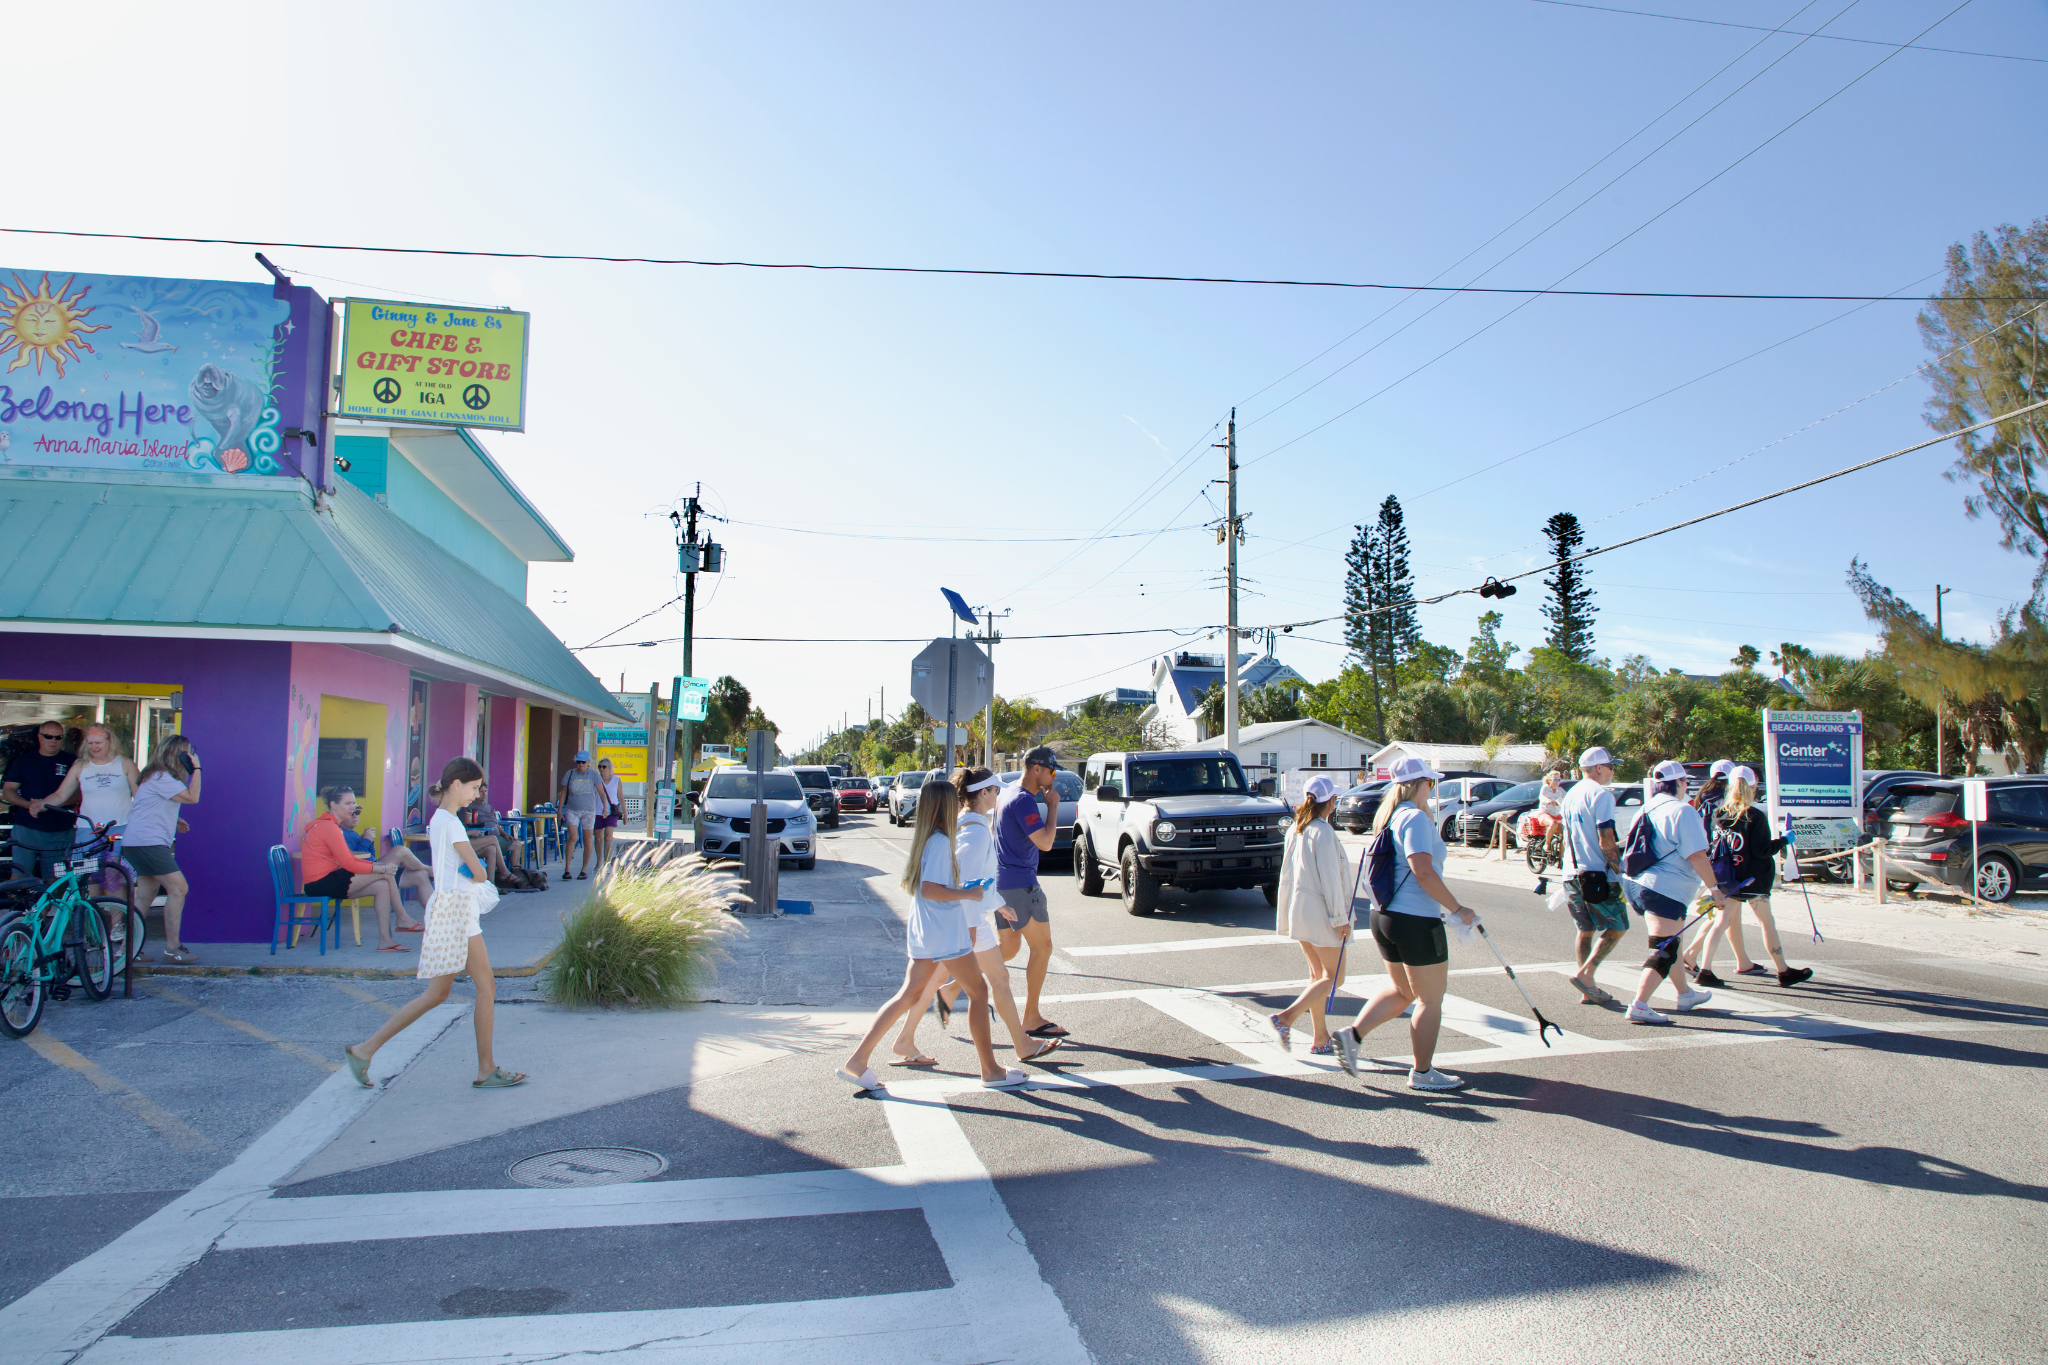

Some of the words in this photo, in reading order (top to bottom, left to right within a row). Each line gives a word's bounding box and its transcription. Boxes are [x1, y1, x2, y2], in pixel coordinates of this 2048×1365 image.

[371, 306, 419, 328] Ginny
[425, 312, 438, 325] &
[443, 312, 479, 328] Jane
[390, 329, 458, 352] CAFE
[465, 337, 483, 354] &
[357, 351, 423, 372] GIFT
[427, 357, 511, 381] STORE
[419, 391, 445, 405] IGA
[118, 390, 194, 438] Here
[348, 405, 374, 414] HOME
[392, 408, 408, 416] THE
[411, 410, 437, 418] GIANT
[440, 412, 486, 421] CINNAMON
[489, 415, 512, 424] ROLL
[33, 433, 83, 453] Anna
[83, 436, 140, 456] Maria
[140, 438, 190, 461] Island
[1771, 713, 1804, 721] BEACH
[1805, 713, 1844, 722] ACCESS
[1771, 723, 1803, 732] BEACH
[1804, 724, 1844, 733] PARKING
[1779, 743, 1828, 757] Center
[1192, 825, 1265, 833] BRONCO
